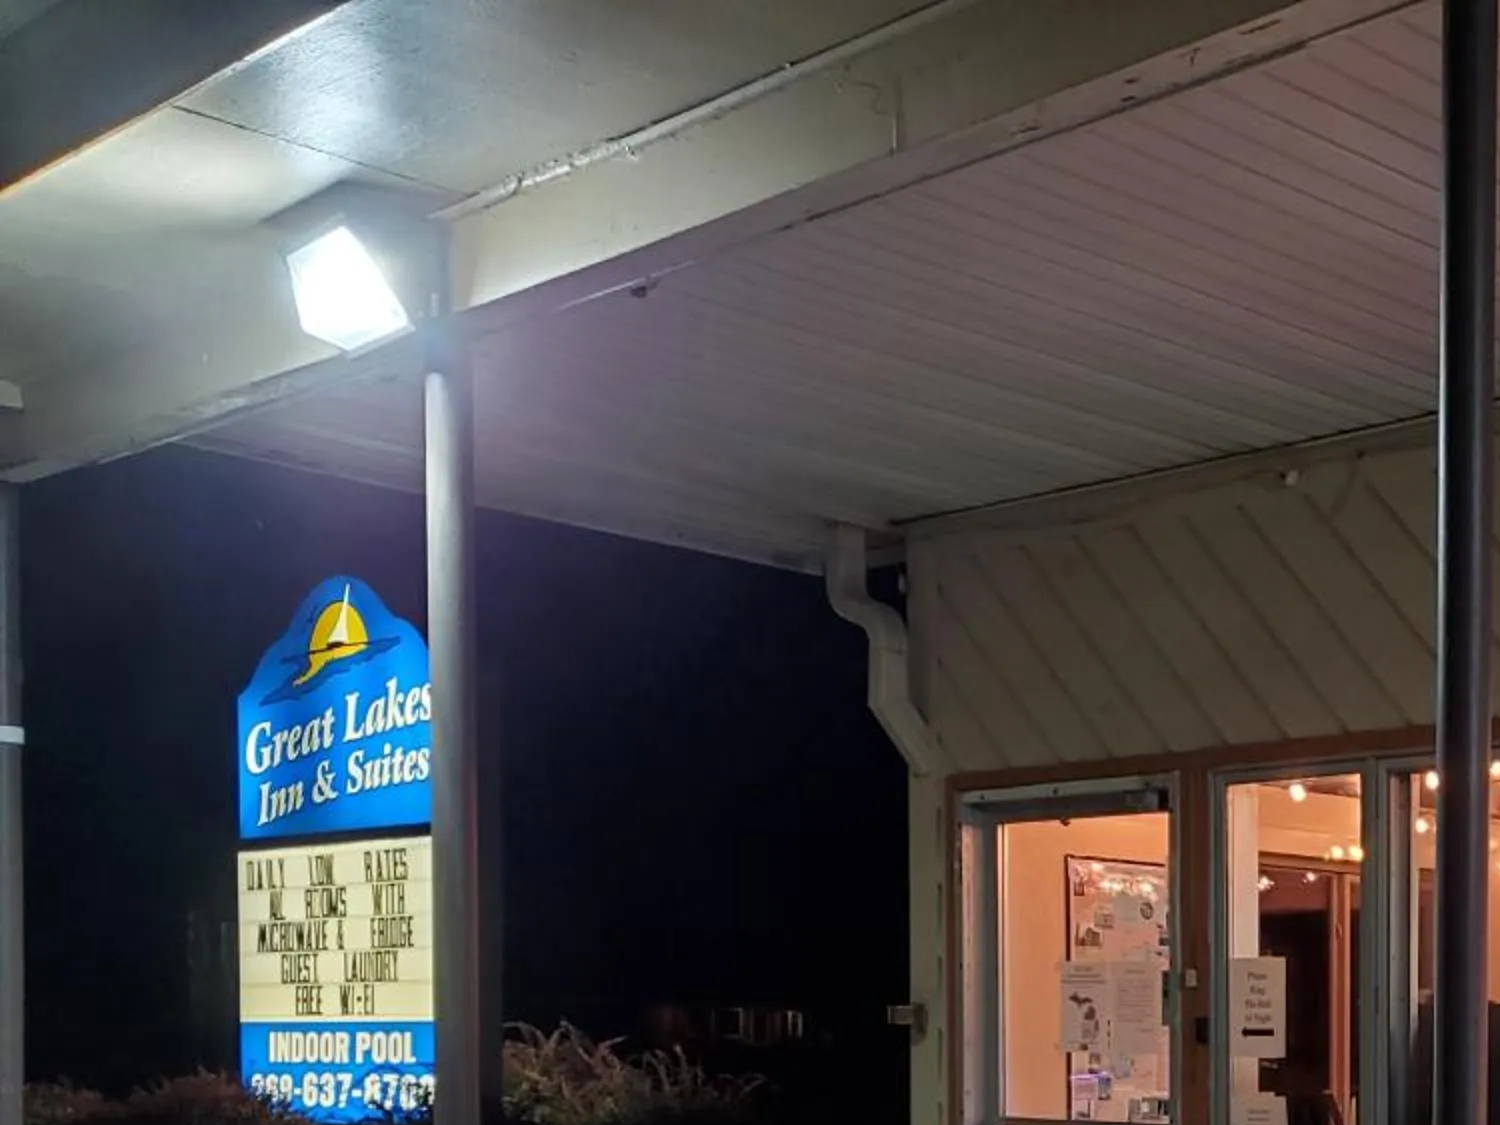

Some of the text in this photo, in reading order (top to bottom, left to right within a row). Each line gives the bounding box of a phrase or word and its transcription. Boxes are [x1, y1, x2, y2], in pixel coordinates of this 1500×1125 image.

[246, 677, 432, 775] Great Lakes
[257, 743, 430, 826] Inn & Suites
[246, 848, 409, 891] DAILY LOW RATES
[305, 887, 347, 918] ROOMS
[372, 883, 405, 915] WITH
[257, 920, 329, 952] MICROWAVE
[370, 916, 414, 948] FRIDGE
[281, 951, 399, 984] GUEST LAUNDRY
[296, 985, 323, 1016] FREE
[269, 1031, 417, 1065] INDOOR POOL
